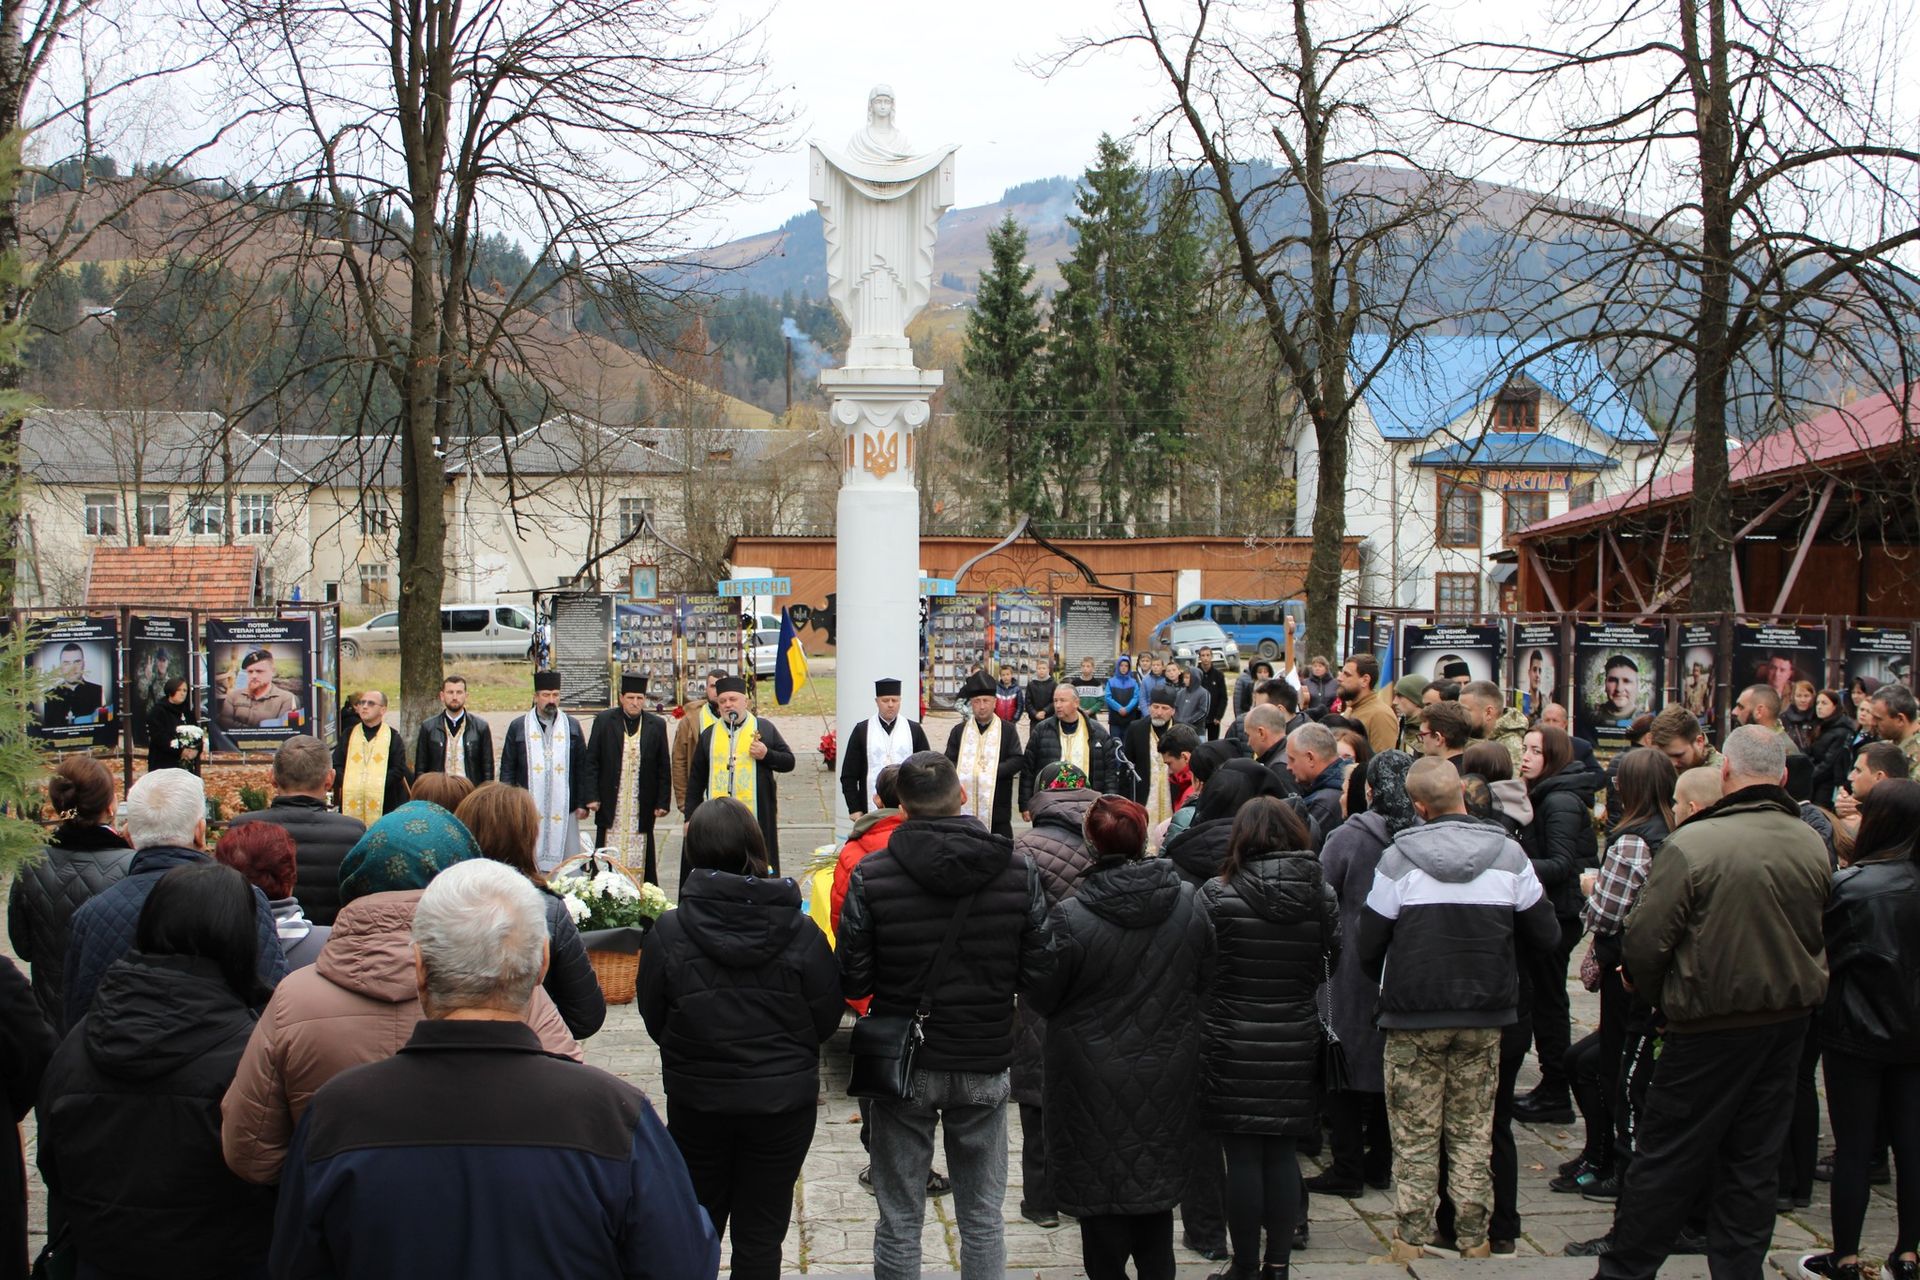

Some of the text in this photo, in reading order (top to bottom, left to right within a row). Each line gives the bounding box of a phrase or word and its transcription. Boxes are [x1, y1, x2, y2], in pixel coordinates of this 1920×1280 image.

[1487, 470, 1569, 490] ПРЕСТИЖ
[724, 581, 788, 595] НЕБЕСНА
[687, 596, 736, 605] НЕБЕСНА
[935, 597, 984, 605] НЕБЕСНА
[693, 605, 729, 614] СОТНЯ
[941, 606, 977, 615] СОТНЯ
